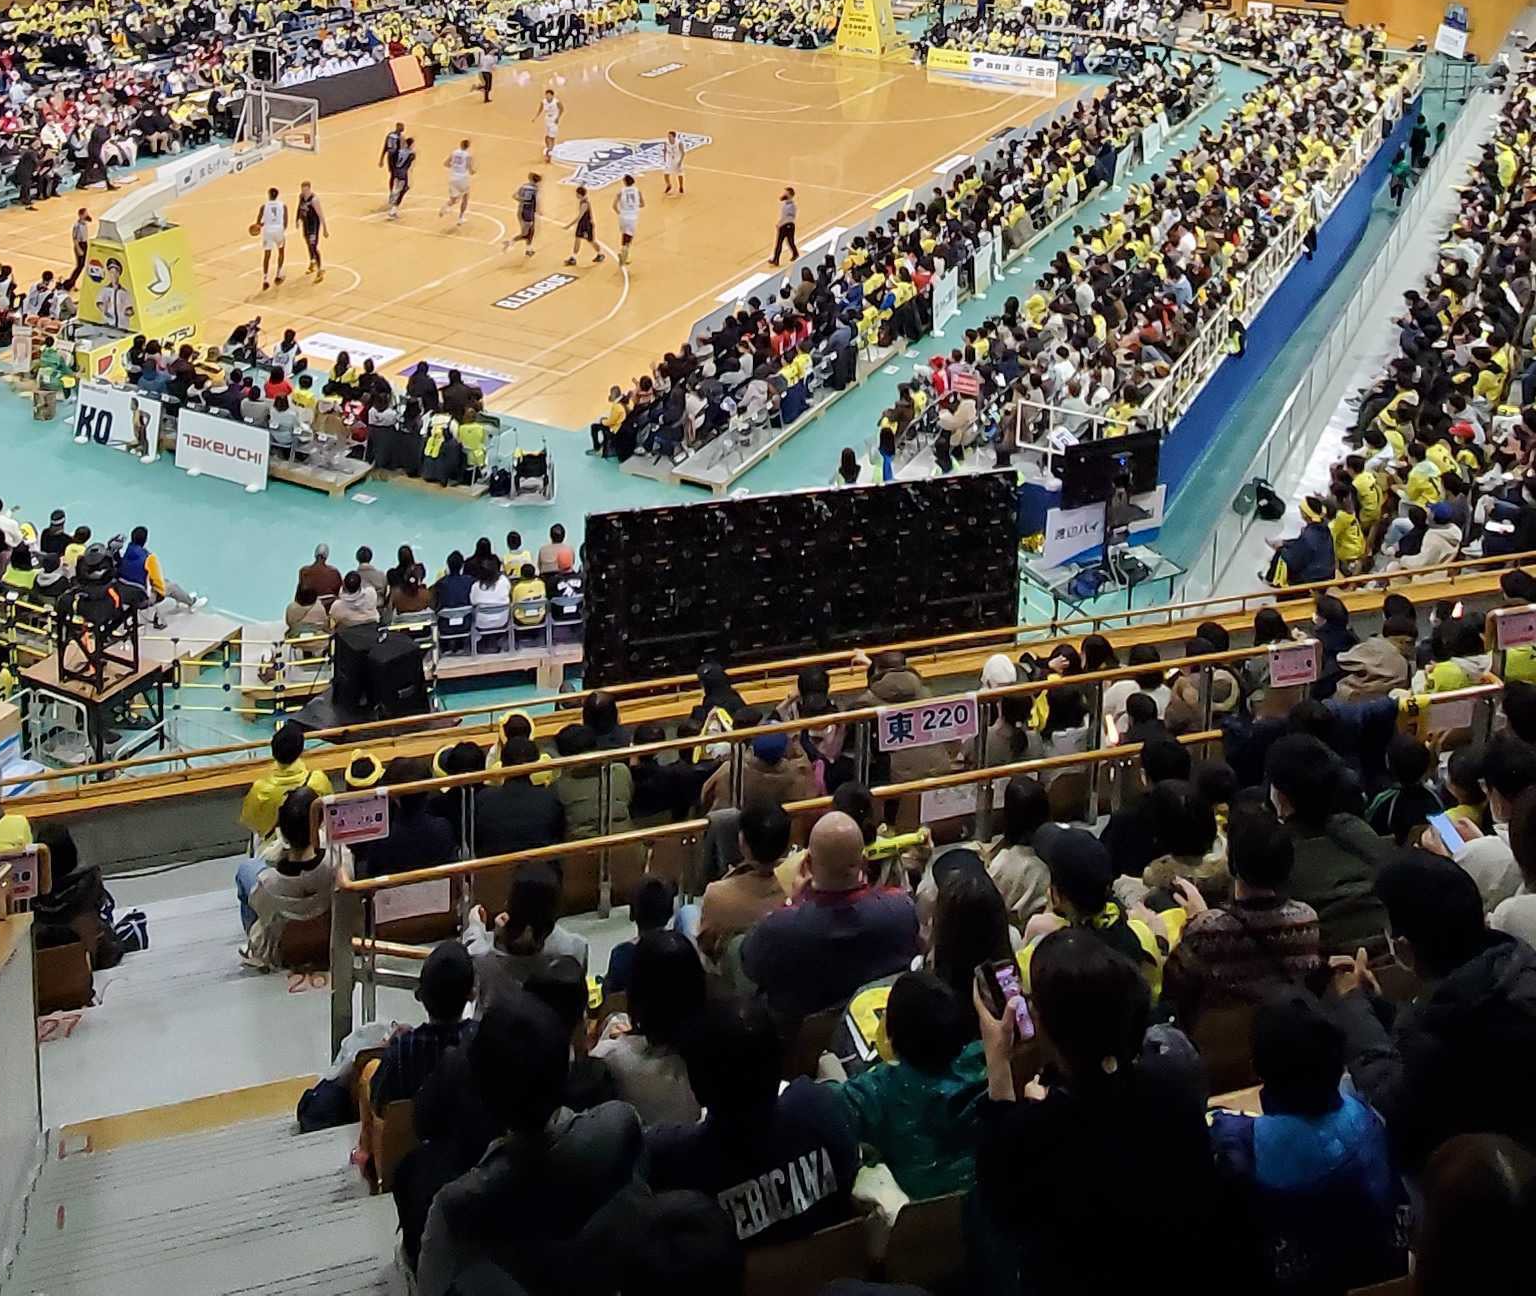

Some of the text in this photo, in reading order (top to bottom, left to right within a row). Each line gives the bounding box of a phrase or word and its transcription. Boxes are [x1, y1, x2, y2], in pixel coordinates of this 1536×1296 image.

[76, 404, 114, 445] KO
[886, 704, 968, 744] 東 220
[39, 1013, 83, 1042] 27
